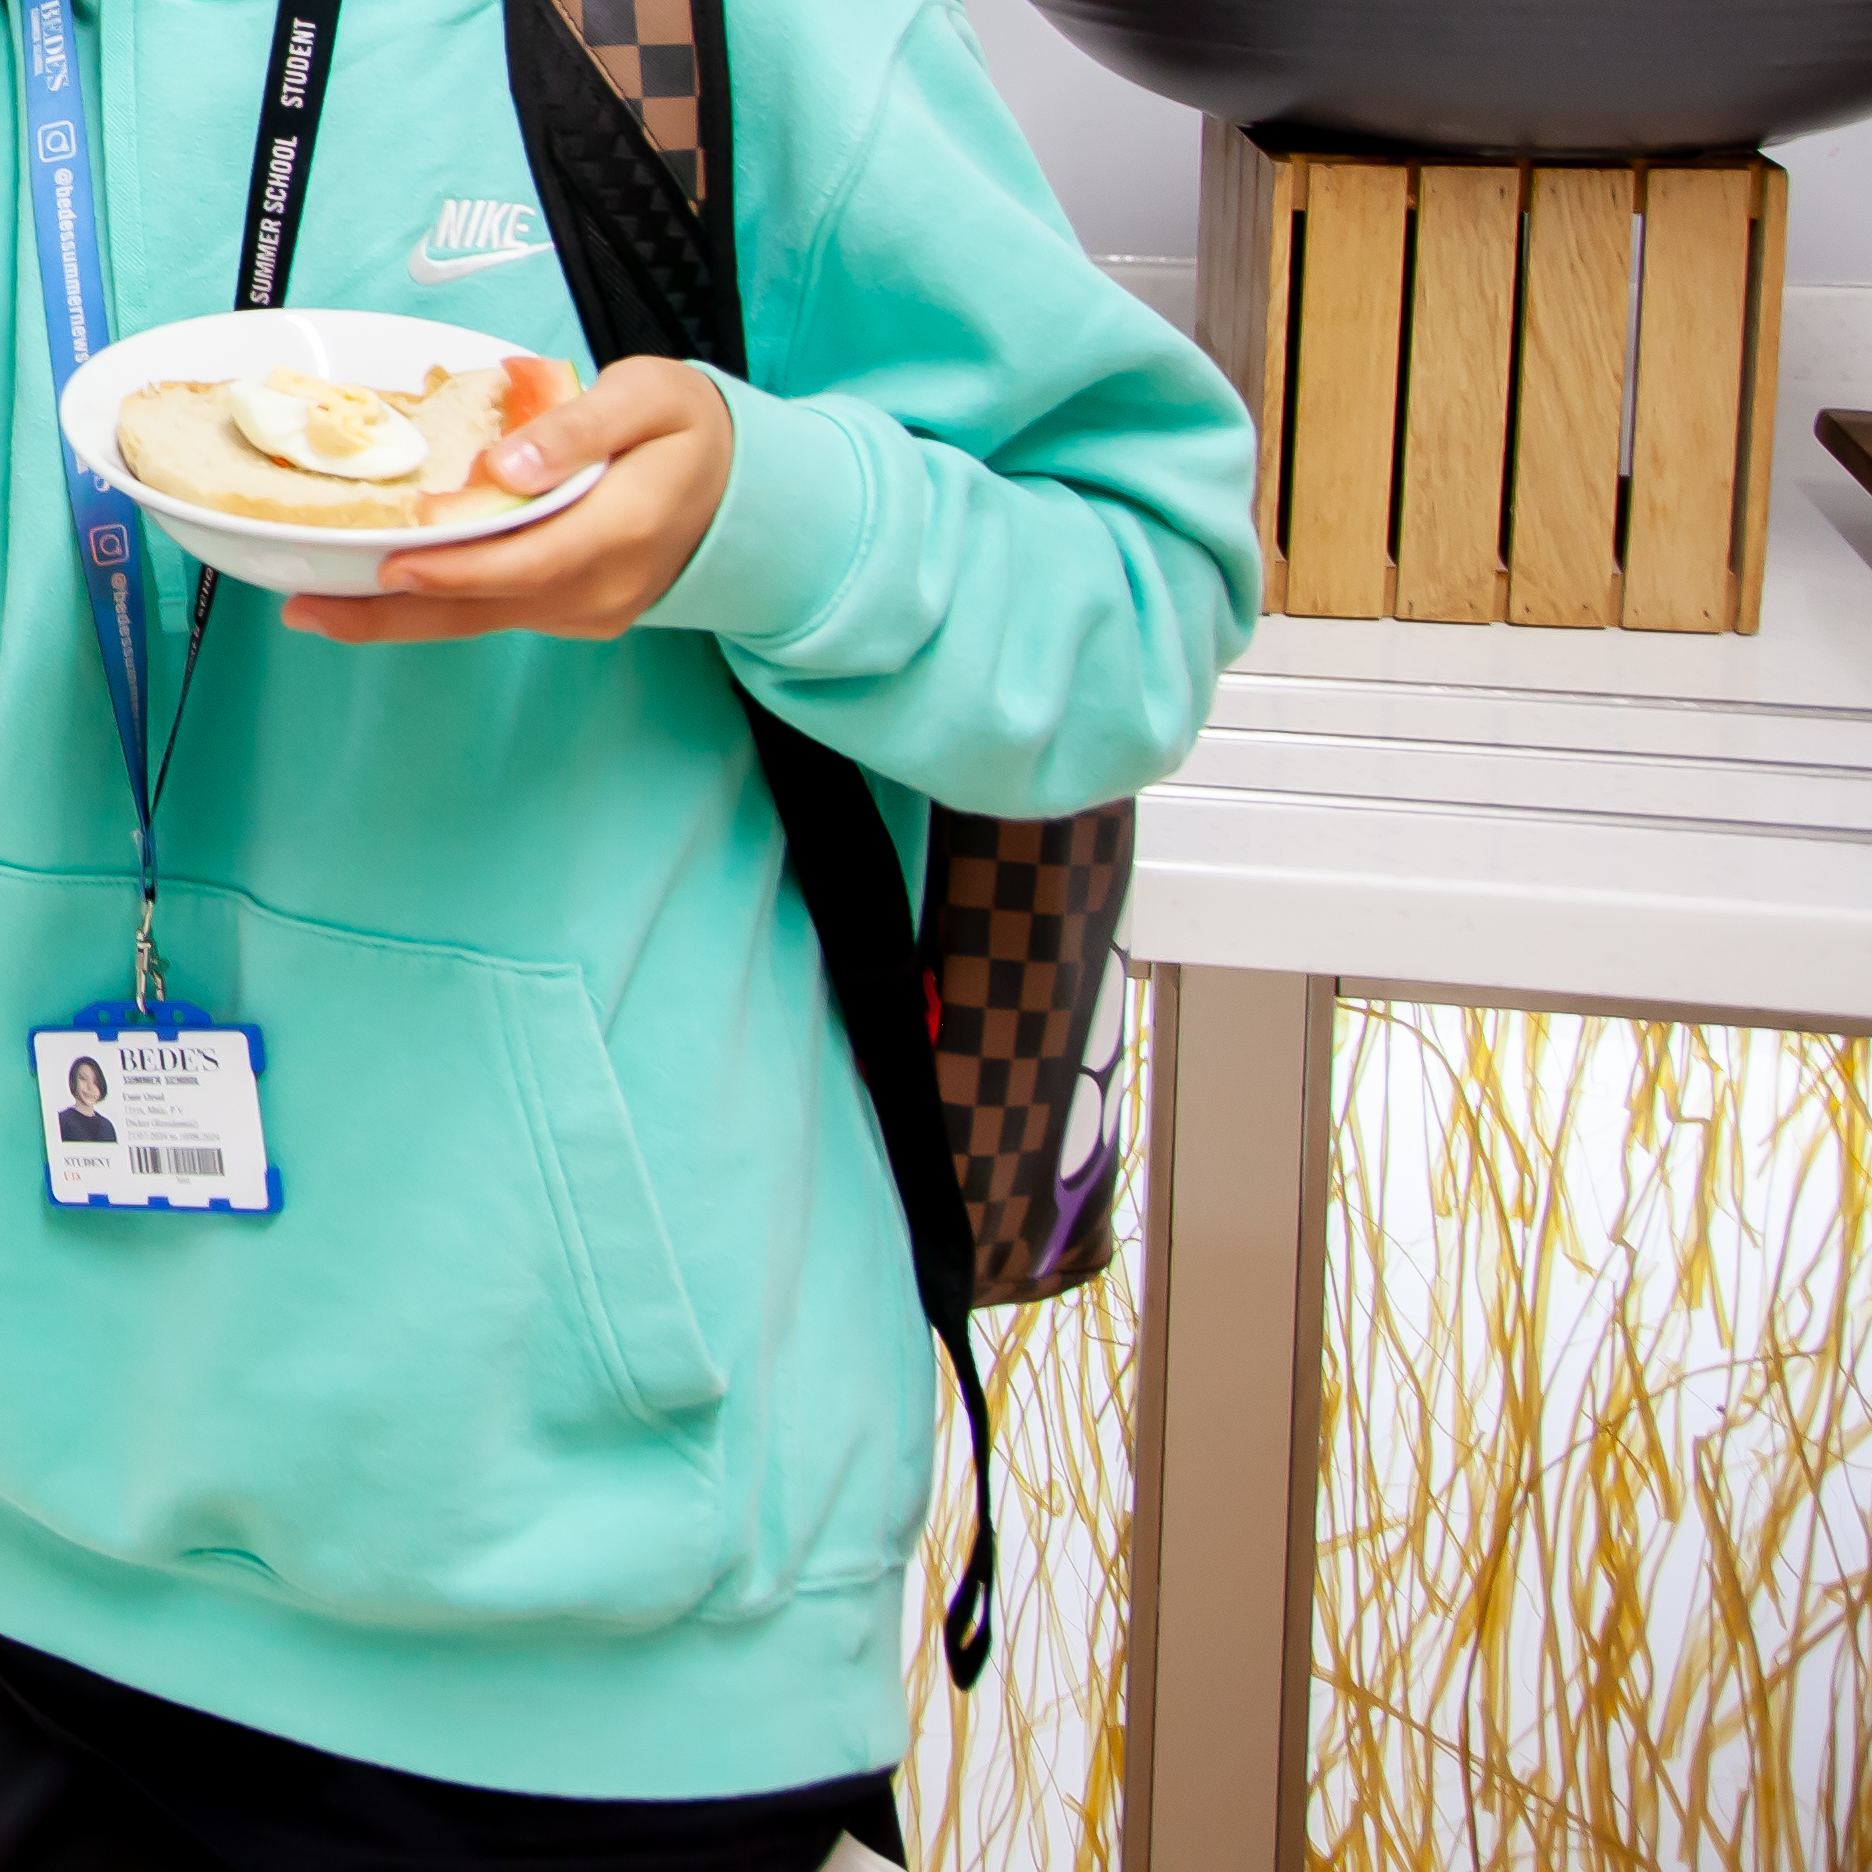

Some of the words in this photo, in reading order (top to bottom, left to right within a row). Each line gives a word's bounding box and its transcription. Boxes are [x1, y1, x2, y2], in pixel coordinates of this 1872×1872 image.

[280, 17, 317, 108] STUDENT
[263, 134, 298, 214] SCHOOL
[249, 218, 282, 306] SUMMER
[434, 199, 536, 249] NIKE
[118, 1047, 219, 1071] BEDE'S
